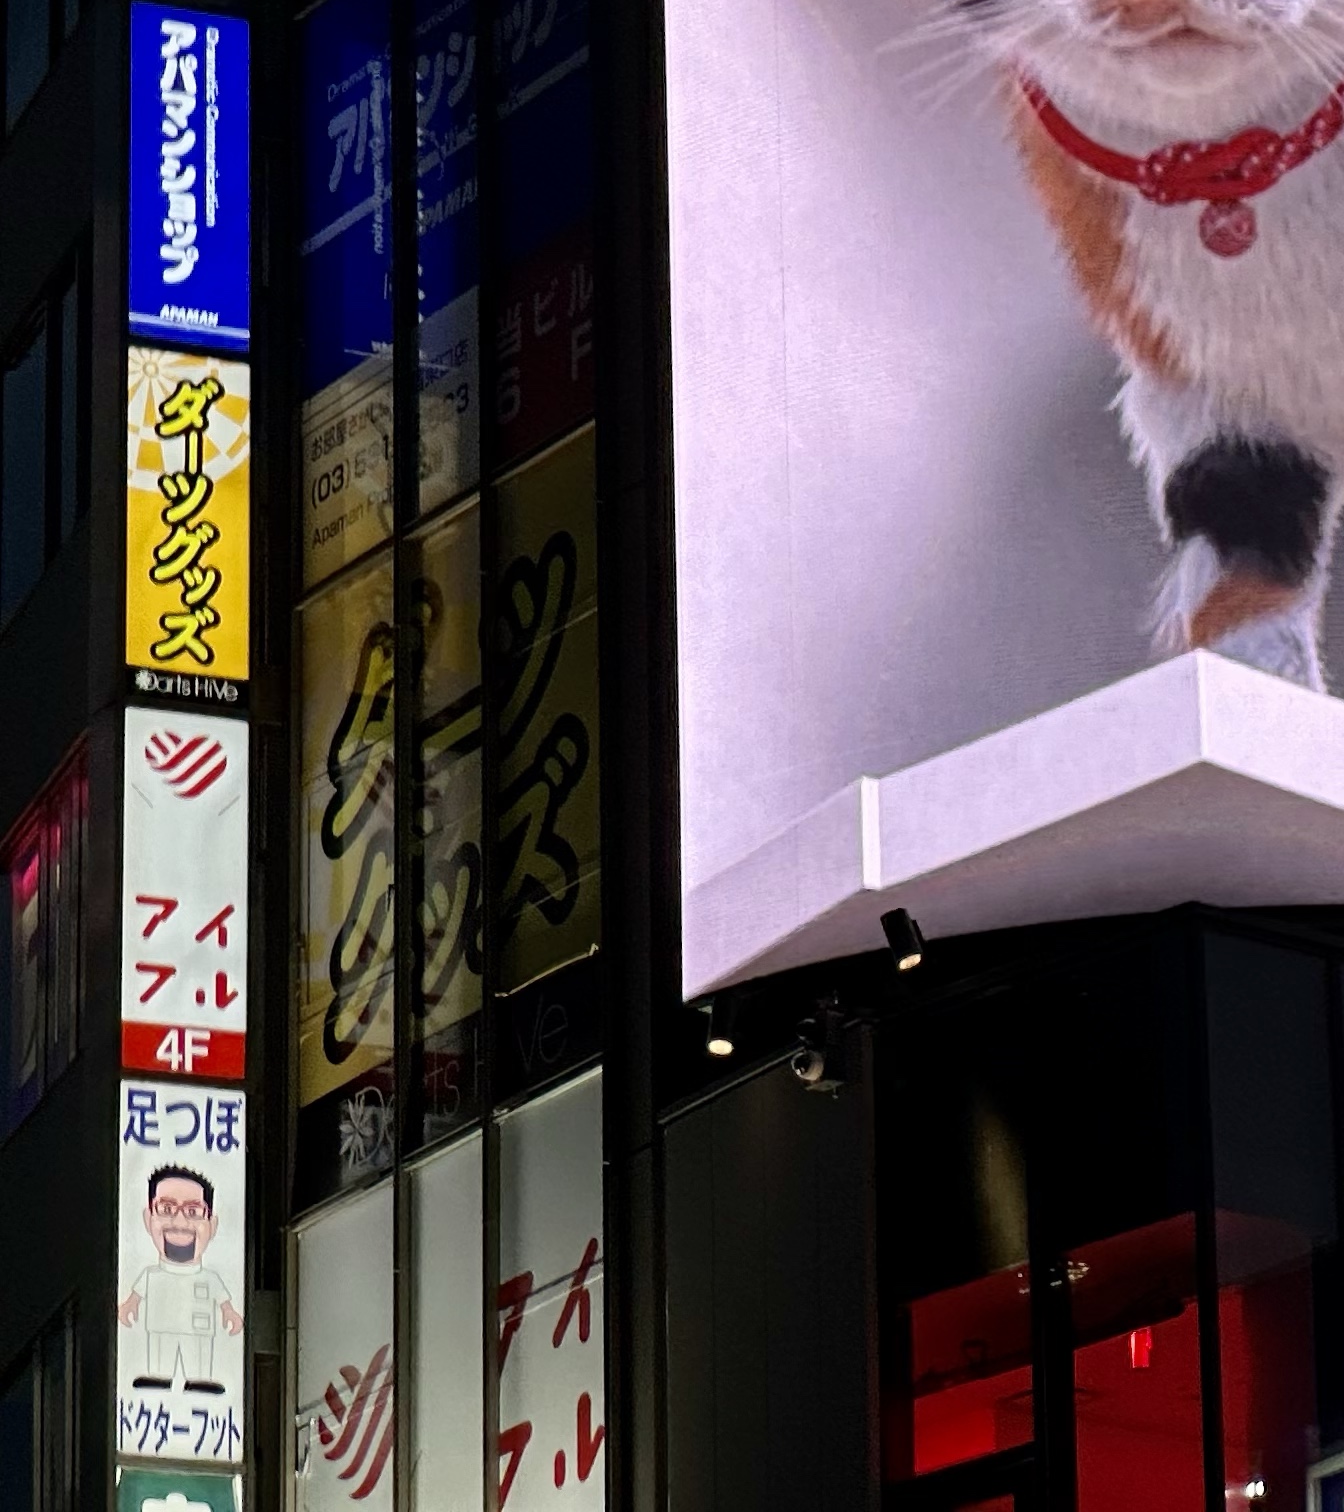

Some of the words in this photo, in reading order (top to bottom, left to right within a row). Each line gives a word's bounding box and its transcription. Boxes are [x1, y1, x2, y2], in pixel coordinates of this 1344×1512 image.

[159, 19, 200, 285] アパマンショップ
[148, 376, 224, 666] ダーツグッズ
[135, 893, 236, 949] アイ
[135, 962, 239, 1010] フル
[155, 1029, 212, 1072] 4F
[122, 1088, 244, 1154] 足つぼ
[118, 1399, 241, 1461] ドクターフット
